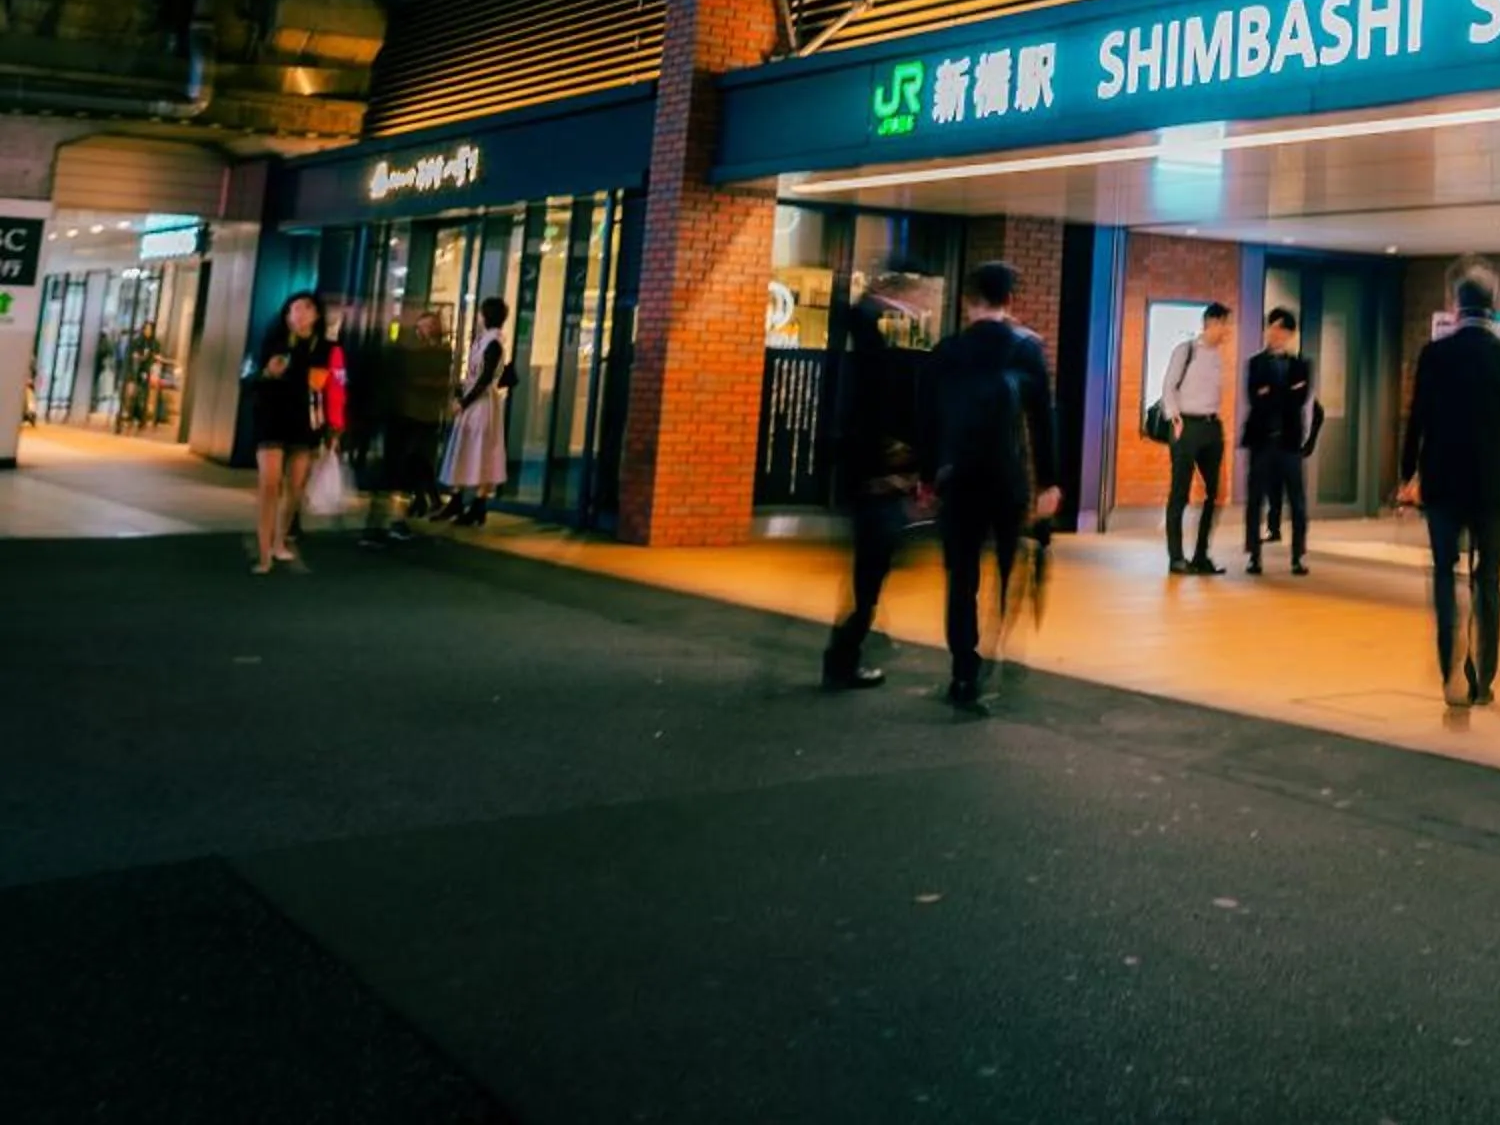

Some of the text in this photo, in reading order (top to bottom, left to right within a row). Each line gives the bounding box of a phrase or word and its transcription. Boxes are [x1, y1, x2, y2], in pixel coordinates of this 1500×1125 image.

[874, 60, 924, 118] JR
[932, 43, 1056, 124] 新橋駅
